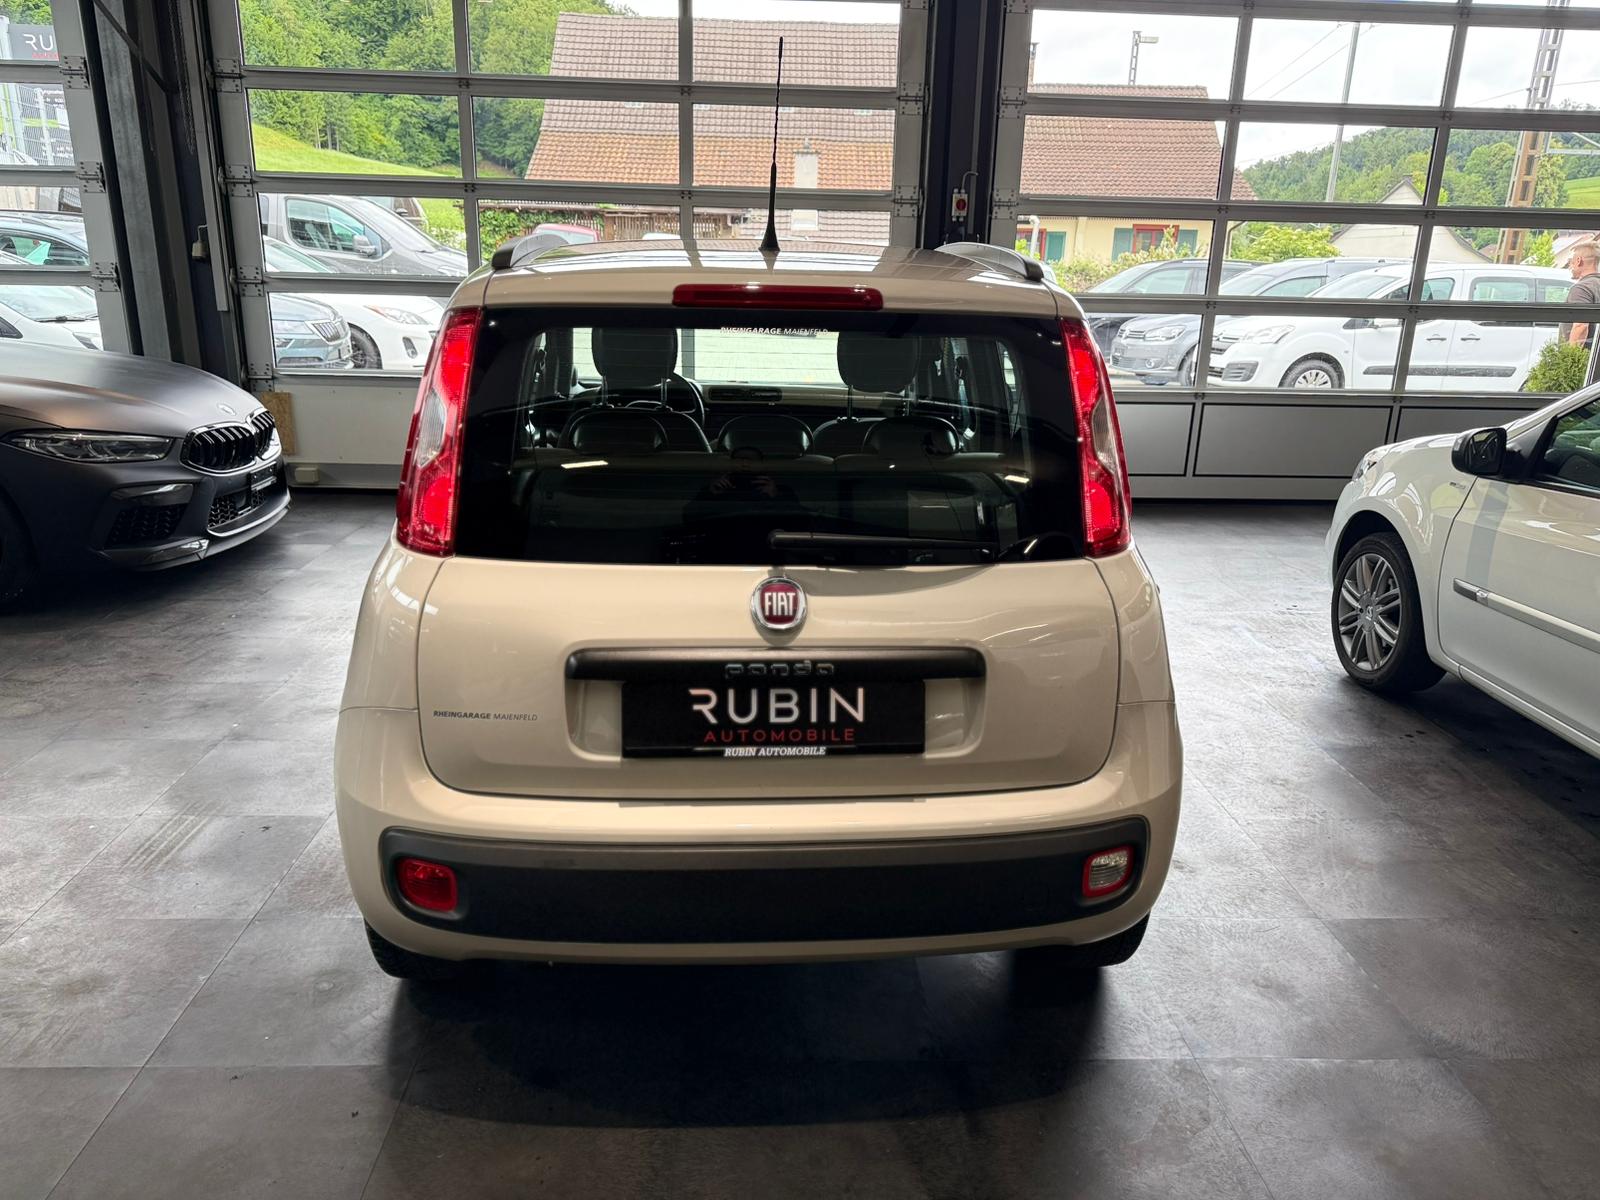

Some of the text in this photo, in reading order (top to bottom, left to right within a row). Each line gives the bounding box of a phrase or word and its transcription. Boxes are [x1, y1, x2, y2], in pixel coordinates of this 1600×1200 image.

[764, 592, 796, 616] FIAT
[725, 660, 834, 678] panda
[688, 688, 864, 724] RUBIN
[433, 710, 538, 721] RHEINGARAGE MAIENFELD
[704, 729, 855, 742] AUTOMOBILE
[724, 747, 826, 757] RUBIN AUTOMOBILE
